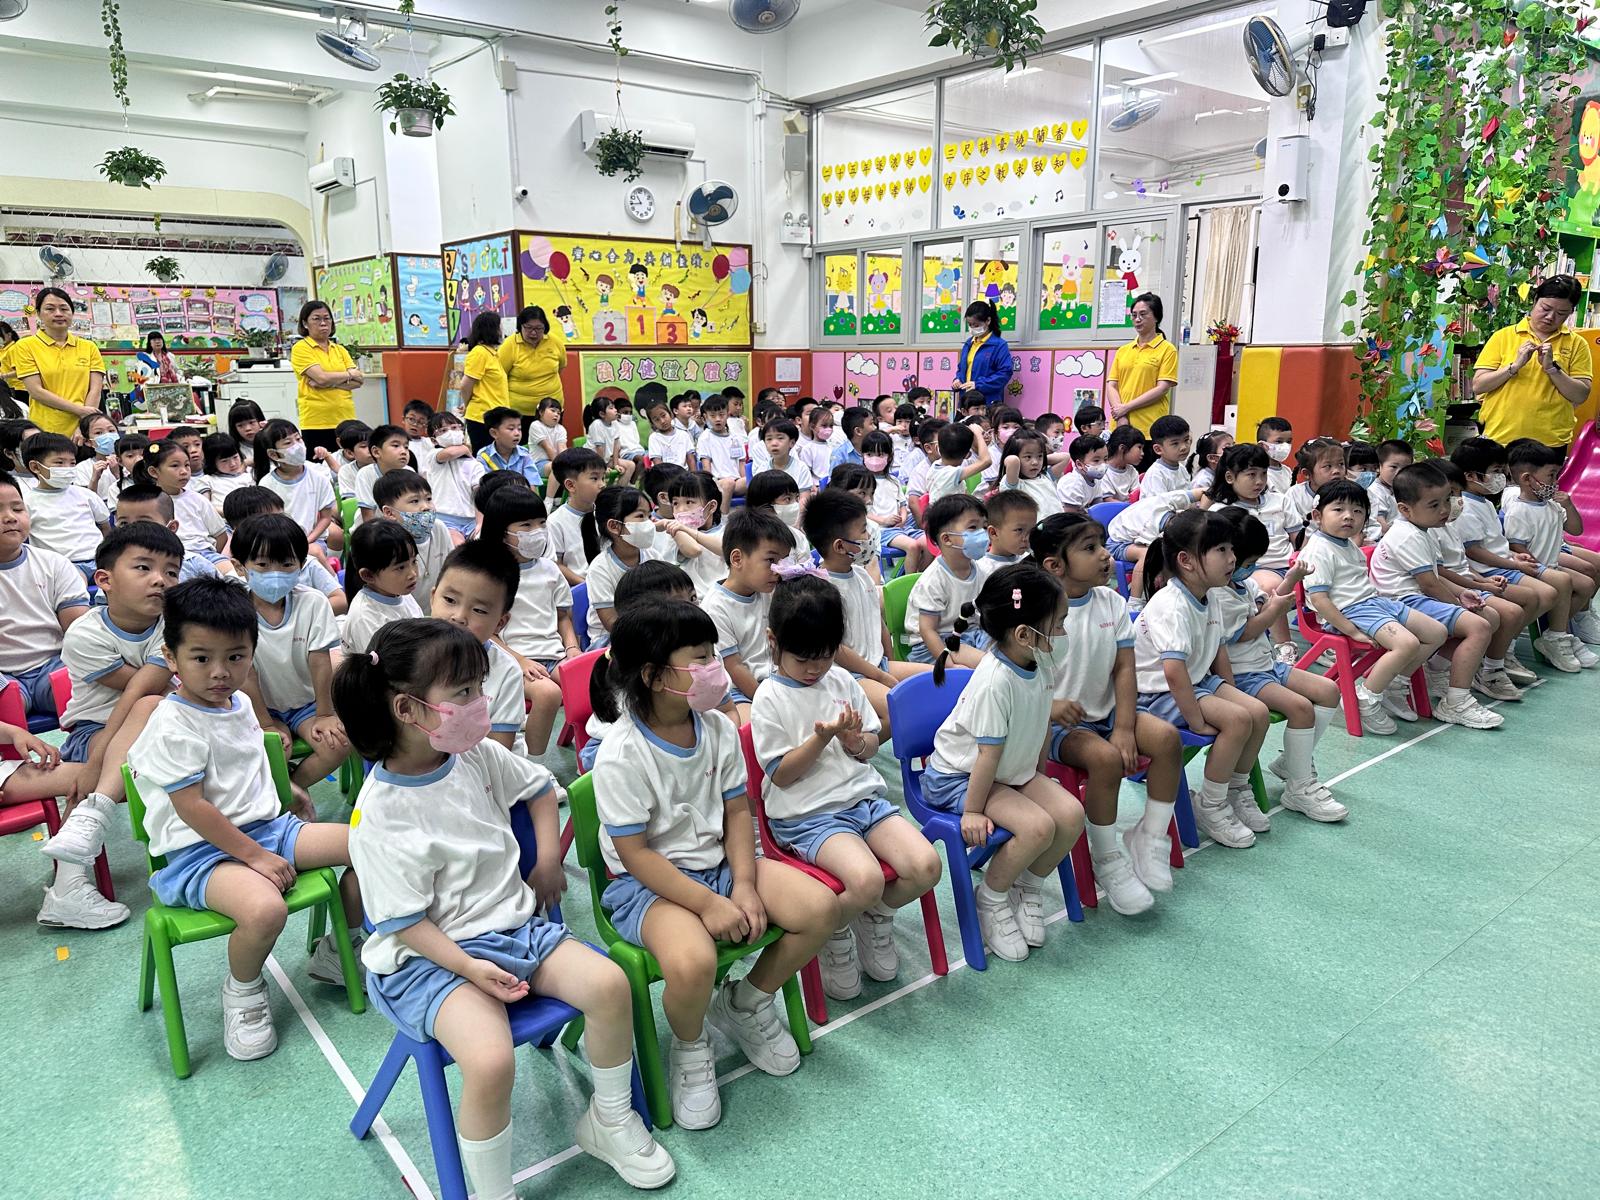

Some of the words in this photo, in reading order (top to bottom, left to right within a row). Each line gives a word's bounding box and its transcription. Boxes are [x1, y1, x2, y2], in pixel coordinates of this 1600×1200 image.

[445, 253, 452, 273] 3
[448, 282, 455, 302] 2
[451, 311, 456, 331] 1
[603, 321, 618, 342] 2
[636, 314, 645, 336] 1
[666, 323, 678, 344] 3
[595, 357, 741, 383] 強身健體身體好
